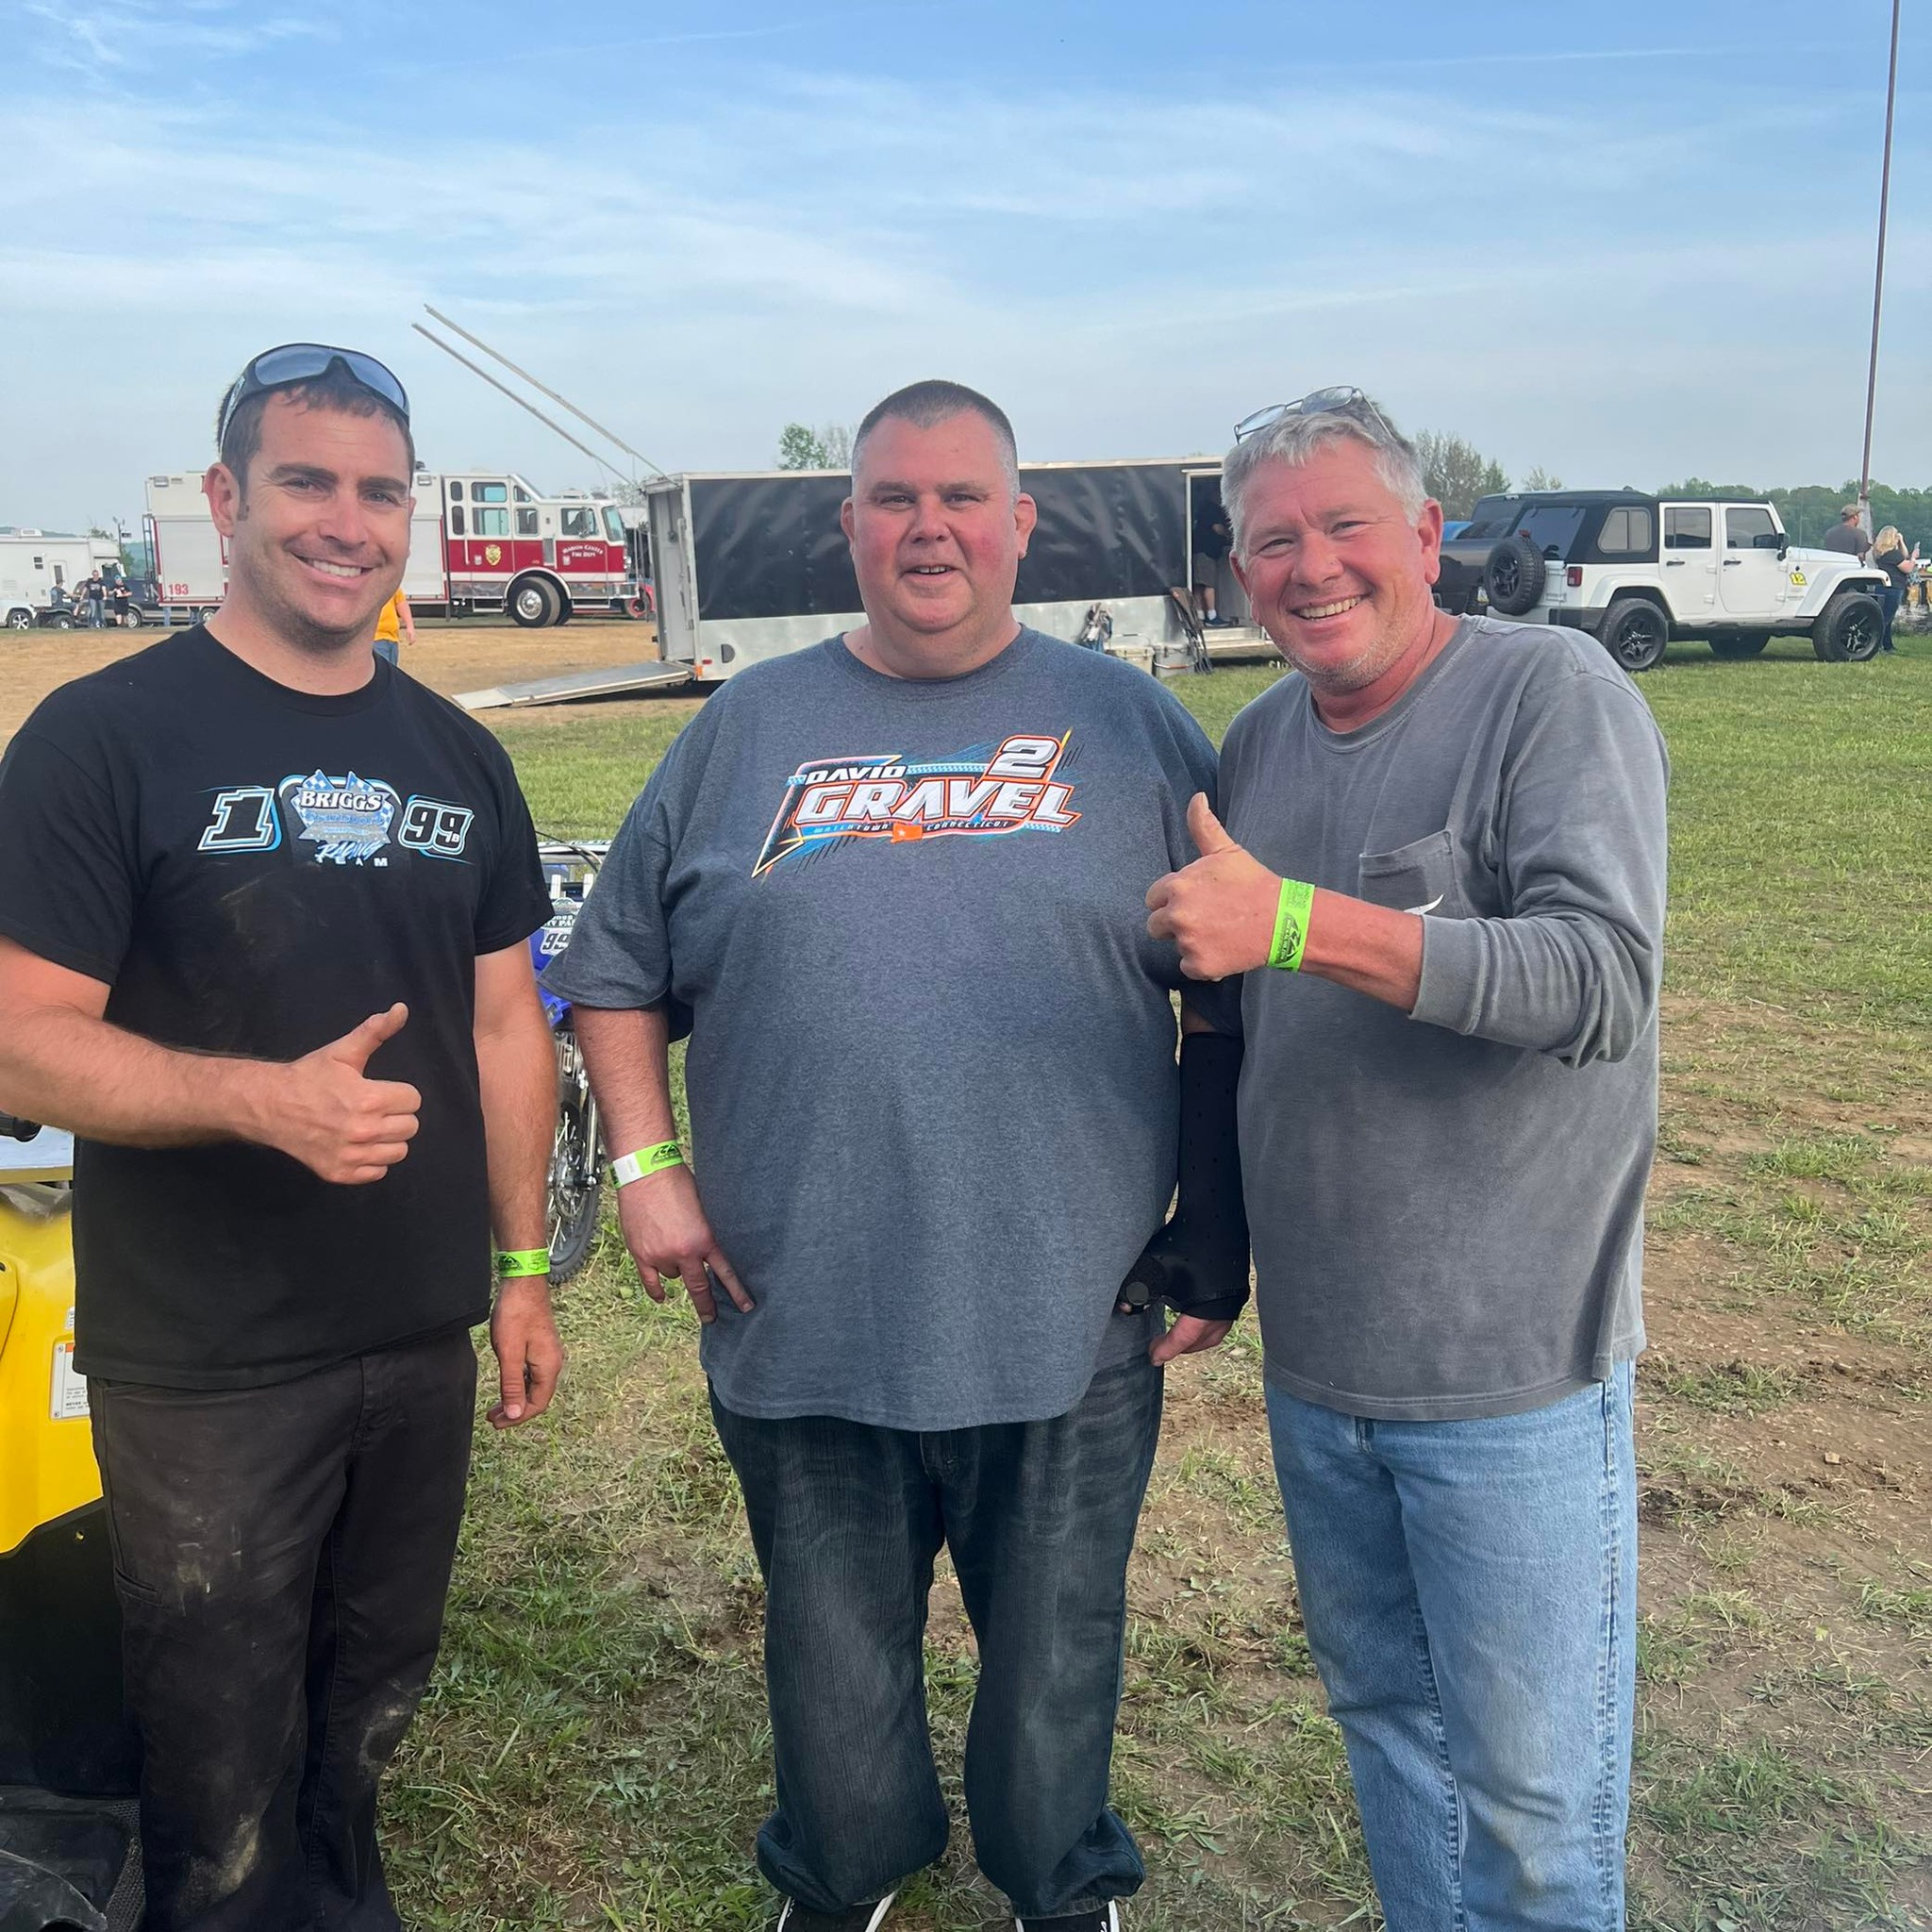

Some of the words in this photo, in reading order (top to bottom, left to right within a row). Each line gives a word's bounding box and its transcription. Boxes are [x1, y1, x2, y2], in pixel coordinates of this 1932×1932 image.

[168, 583, 189, 595] 193
[988, 735, 1061, 779] 2
[805, 764, 908, 786] DAVID
[300, 790, 382, 811] BRIGGS
[794, 777, 1081, 827] GRAVEL
[199, 789, 275, 850] 1
[399, 800, 474, 854] 99
[314, 854, 388, 867] TEAM
[317, 840, 386, 860] RACING
[542, 934, 570, 949] 99
